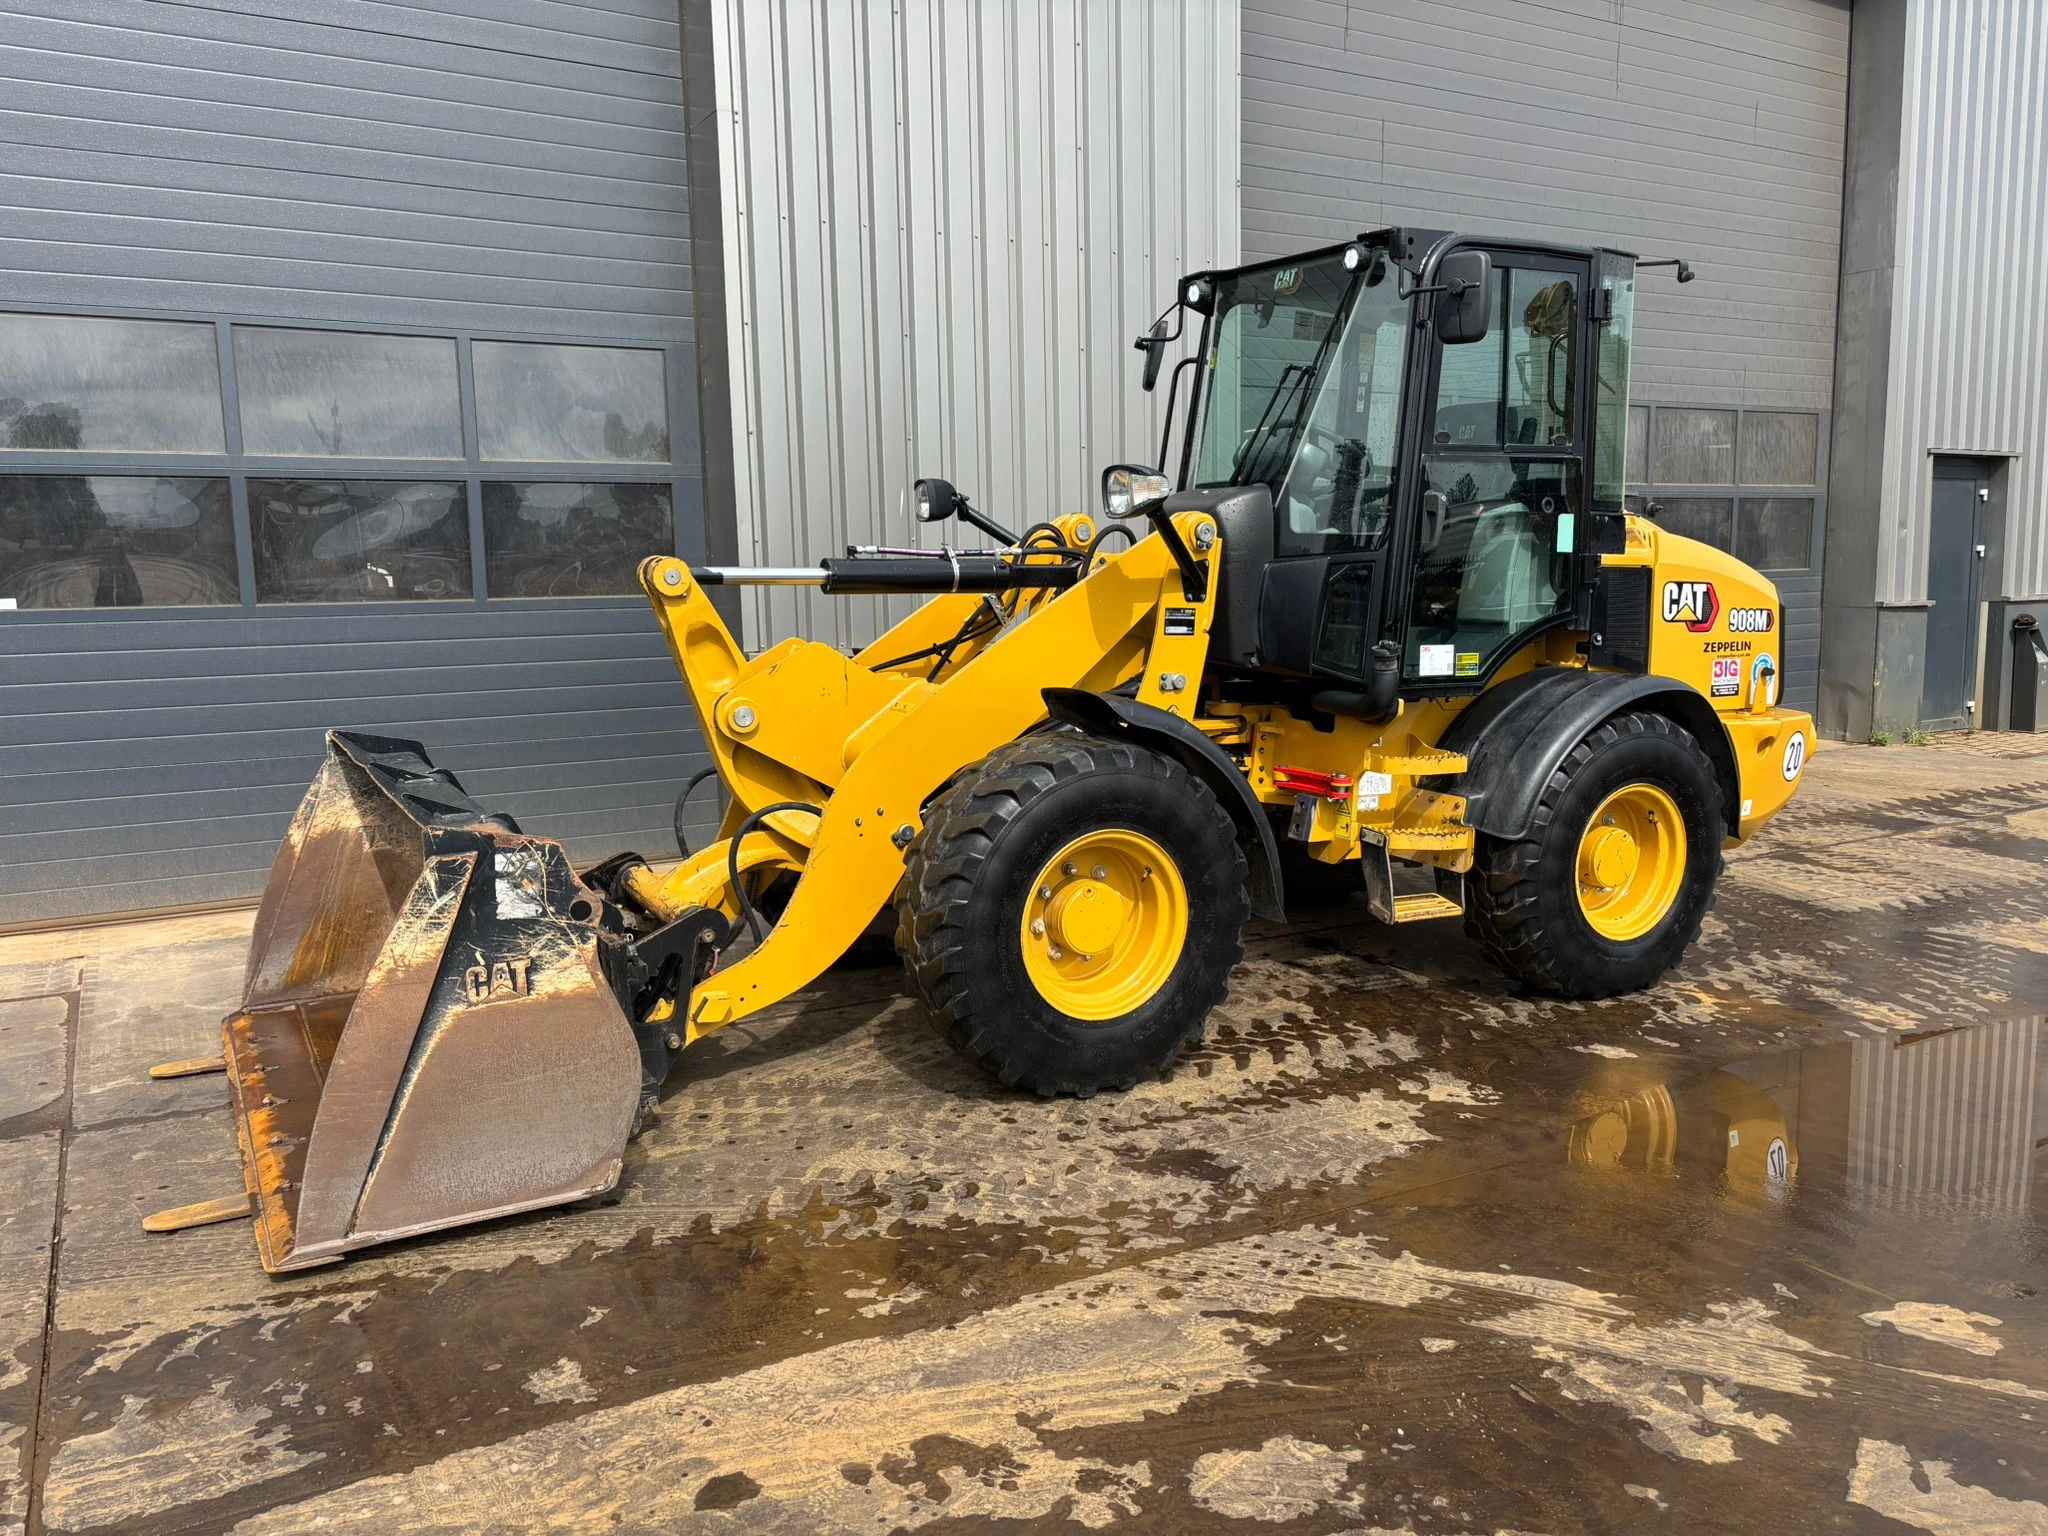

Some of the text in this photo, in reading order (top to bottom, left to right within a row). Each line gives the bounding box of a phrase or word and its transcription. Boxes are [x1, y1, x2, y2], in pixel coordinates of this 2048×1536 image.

[1274, 267, 1298, 290] CAT
[1663, 582, 1708, 621] CAT
[1729, 608, 1768, 632] 908M
[1703, 640, 1752, 653] ZEPPELIN
[1786, 741, 1802, 772] 20
[465, 956, 532, 1004] CAT
